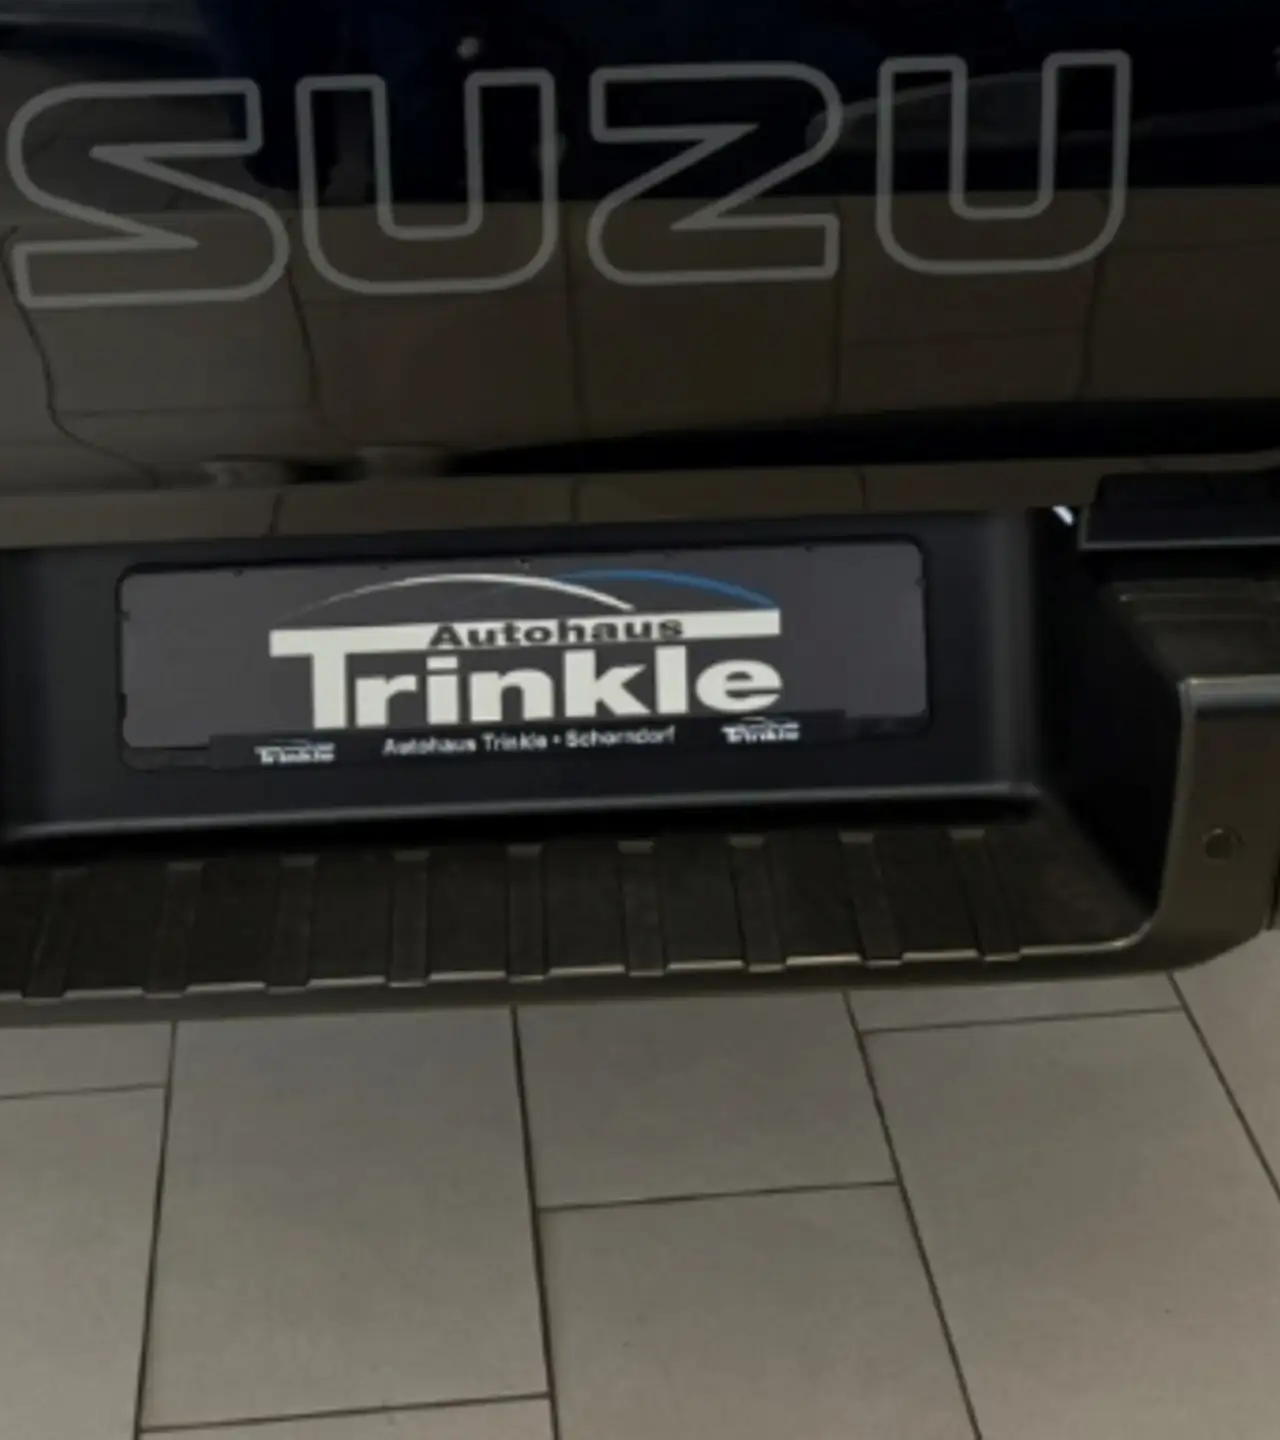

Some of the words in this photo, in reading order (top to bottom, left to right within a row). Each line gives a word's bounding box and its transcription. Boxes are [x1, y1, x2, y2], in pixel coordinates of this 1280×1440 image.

[428, 618, 684, 649] Autohaus
[269, 609, 783, 729] Trinkle
[382, 736, 477, 757] Autohaus
